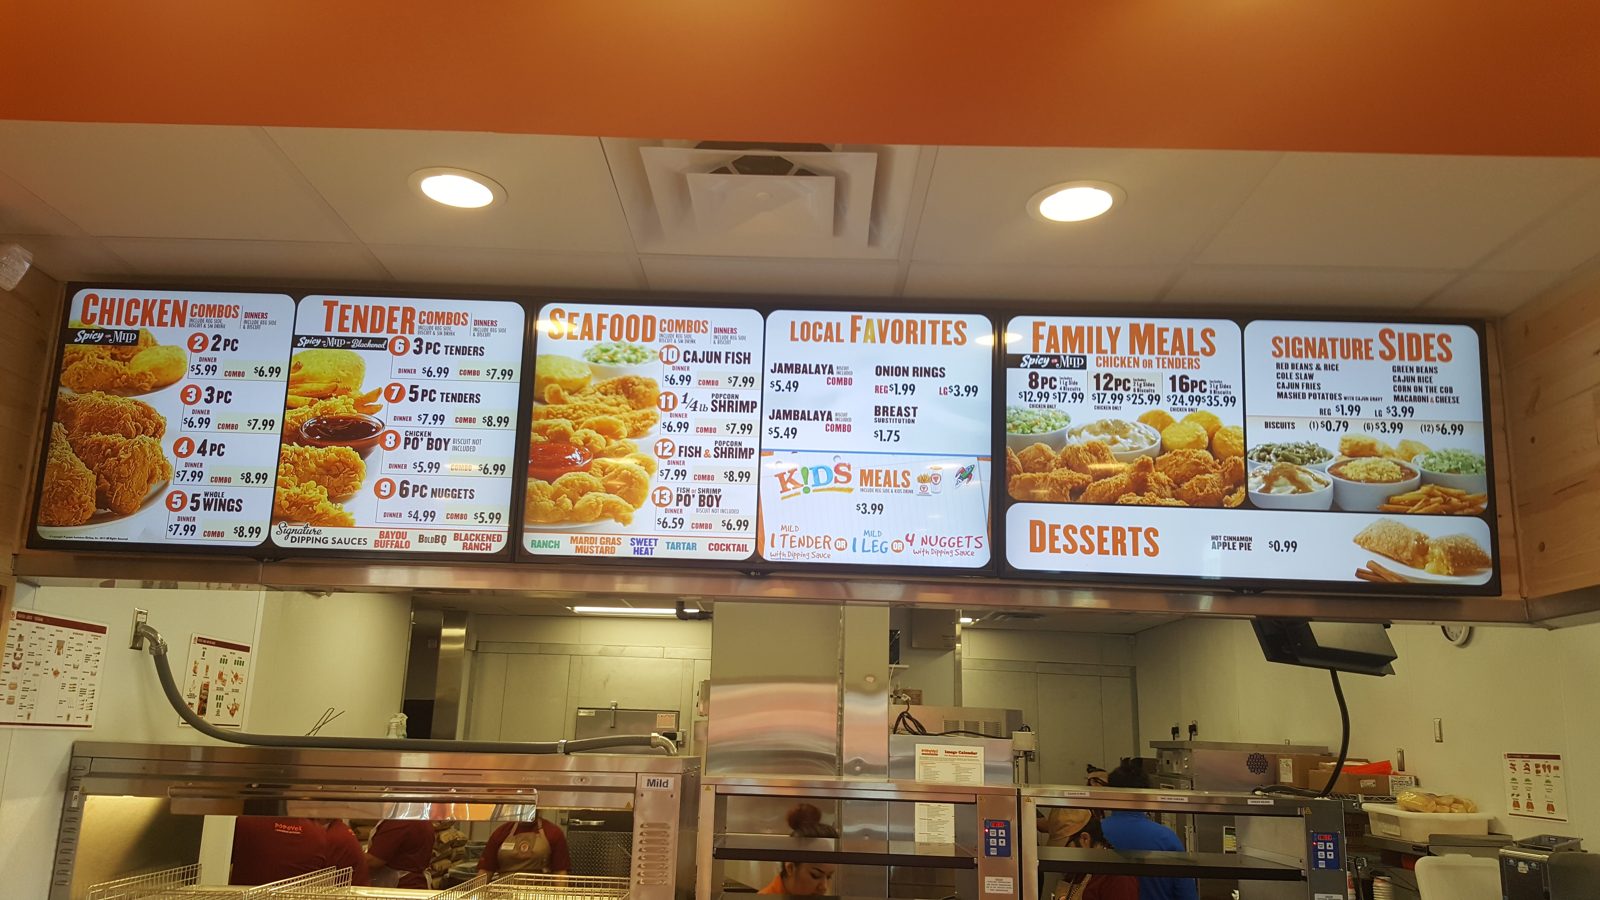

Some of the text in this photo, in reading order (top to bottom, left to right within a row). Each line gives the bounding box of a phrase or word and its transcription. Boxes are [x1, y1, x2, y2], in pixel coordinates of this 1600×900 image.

[80, 293, 240, 328] CHICKEN COMBOS
[323, 300, 469, 335] TENDER COMBOS
[473, 319, 498, 327] DINNERS
[548, 307, 709, 343] SEAFOOD COMBOS
[790, 314, 968, 346] LOCAL FAVORITES
[74, 330, 103, 343] Spicy
[297, 336, 387, 350] Spicy Blackened
[1032, 321, 1216, 357] FAMILY MEALS
[444, 346, 485, 357] TENDERS
[1271, 327, 1453, 363] SIGNATURE SIDES
[683, 351, 752, 365] CAJUN FISH
[1020, 355, 1050, 368] Spicy
[1095, 356, 1140, 368] CHICKEN
[1155, 357, 1201, 370] TENDERS
[190, 364, 282, 378] $5.99 $6.99
[421, 366, 513, 381] $6.99 $7.99
[770, 363, 835, 376] JAMBALAYA
[875, 365, 946, 378] ONION RINGS
[1291, 363, 1314, 371] BEANS
[1324, 364, 1340, 372] RICE
[1392, 365, 1439, 374] GREEN BEANS
[664, 374, 755, 388] $6.99 $7.99
[1276, 372, 1315, 381] COLE SLAW
[1392, 375, 1434, 384] CAJUN RICE
[770, 377, 853, 392] $5.49 COMBO
[874, 383, 916, 396] REG $1.99
[939, 385, 978, 397] LG $3.99
[1276, 382, 1321, 390] CAJUN FRIES
[1393, 385, 1454, 394] CORN ON THE COB
[440, 393, 481, 404] TENDERS
[1018, 391, 1084, 404] $12.99 $17.99
[1091, 393, 1161, 406] $17.99 $25.99
[1166, 395, 1236, 407] $24.99 $35.99
[1276, 392, 1343, 401] MASHED POTATOES
[1393, 395, 1460, 404] MACARONI CHEESE
[710, 400, 758, 413] SHRIMP
[874, 406, 918, 418] BREAST
[1319, 404, 1415, 418] REG $1.99 LG $3.99
[417, 413, 510, 428] $7.99 $8.99
[768, 409, 833, 422] JAMBALAYA
[183, 417, 275, 431] $6.99 $7.99
[1264, 421, 1464, 436] BISCUITS $0.79 $3.99 $6.99
[404, 430, 432, 438] CHICKEN
[873, 430, 901, 442] $1.75
[426, 438, 451, 451] BOY
[678, 446, 755, 459] FISH & SHRIMP
[412, 461, 506, 475] $5.99 $6.99
[175, 470, 204, 482] $7.99
[240, 472, 268, 484] $8.99
[659, 469, 751, 482] $7.99 $8.99
[860, 469, 911, 488] MEALS
[430, 488, 475, 500] NUGGETS
[189, 493, 201, 512] 5
[203, 498, 243, 512] WINGS
[698, 495, 722, 508] BOY
[856, 503, 884, 515] $3.99
[408, 510, 502, 524] $4.99 $5.99
[168, 524, 261, 538] $7.99 $8.99
[275, 521, 322, 541] Signature
[657, 518, 749, 531] $6.59 $6.99
[780, 525, 800, 533] MILD
[379, 530, 408, 540] BAYOU
[453, 533, 503, 543] BLACKENED
[863, 529, 882, 537] MILD
[1029, 519, 1160, 558] DESSERTS
[290, 535, 368, 546] DIPPING SAUCES
[373, 539, 411, 549] BUFFALO
[462, 542, 493, 551] RANCH
[530, 540, 560, 549] RANCH
[570, 536, 622, 546] MARDI GRAS
[630, 538, 659, 547] SWEET
[666, 541, 697, 551] TARTAR
[780, 534, 832, 550] TENDER
[861, 539, 888, 553] LEG
[920, 535, 984, 549] NUGGETS
[1211, 541, 1252, 551] APPLE PIE
[1268, 540, 1298, 553] $0.99
[575, 545, 616, 555] MUSTARD
[633, 547, 654, 556] HEAT
[708, 543, 749, 552] COCKTAIL
[912, 548, 975, 559] with Dipping Sauce
[770, 550, 831, 560] with Dipping Sauce
[646, 778, 669, 788] Mild
